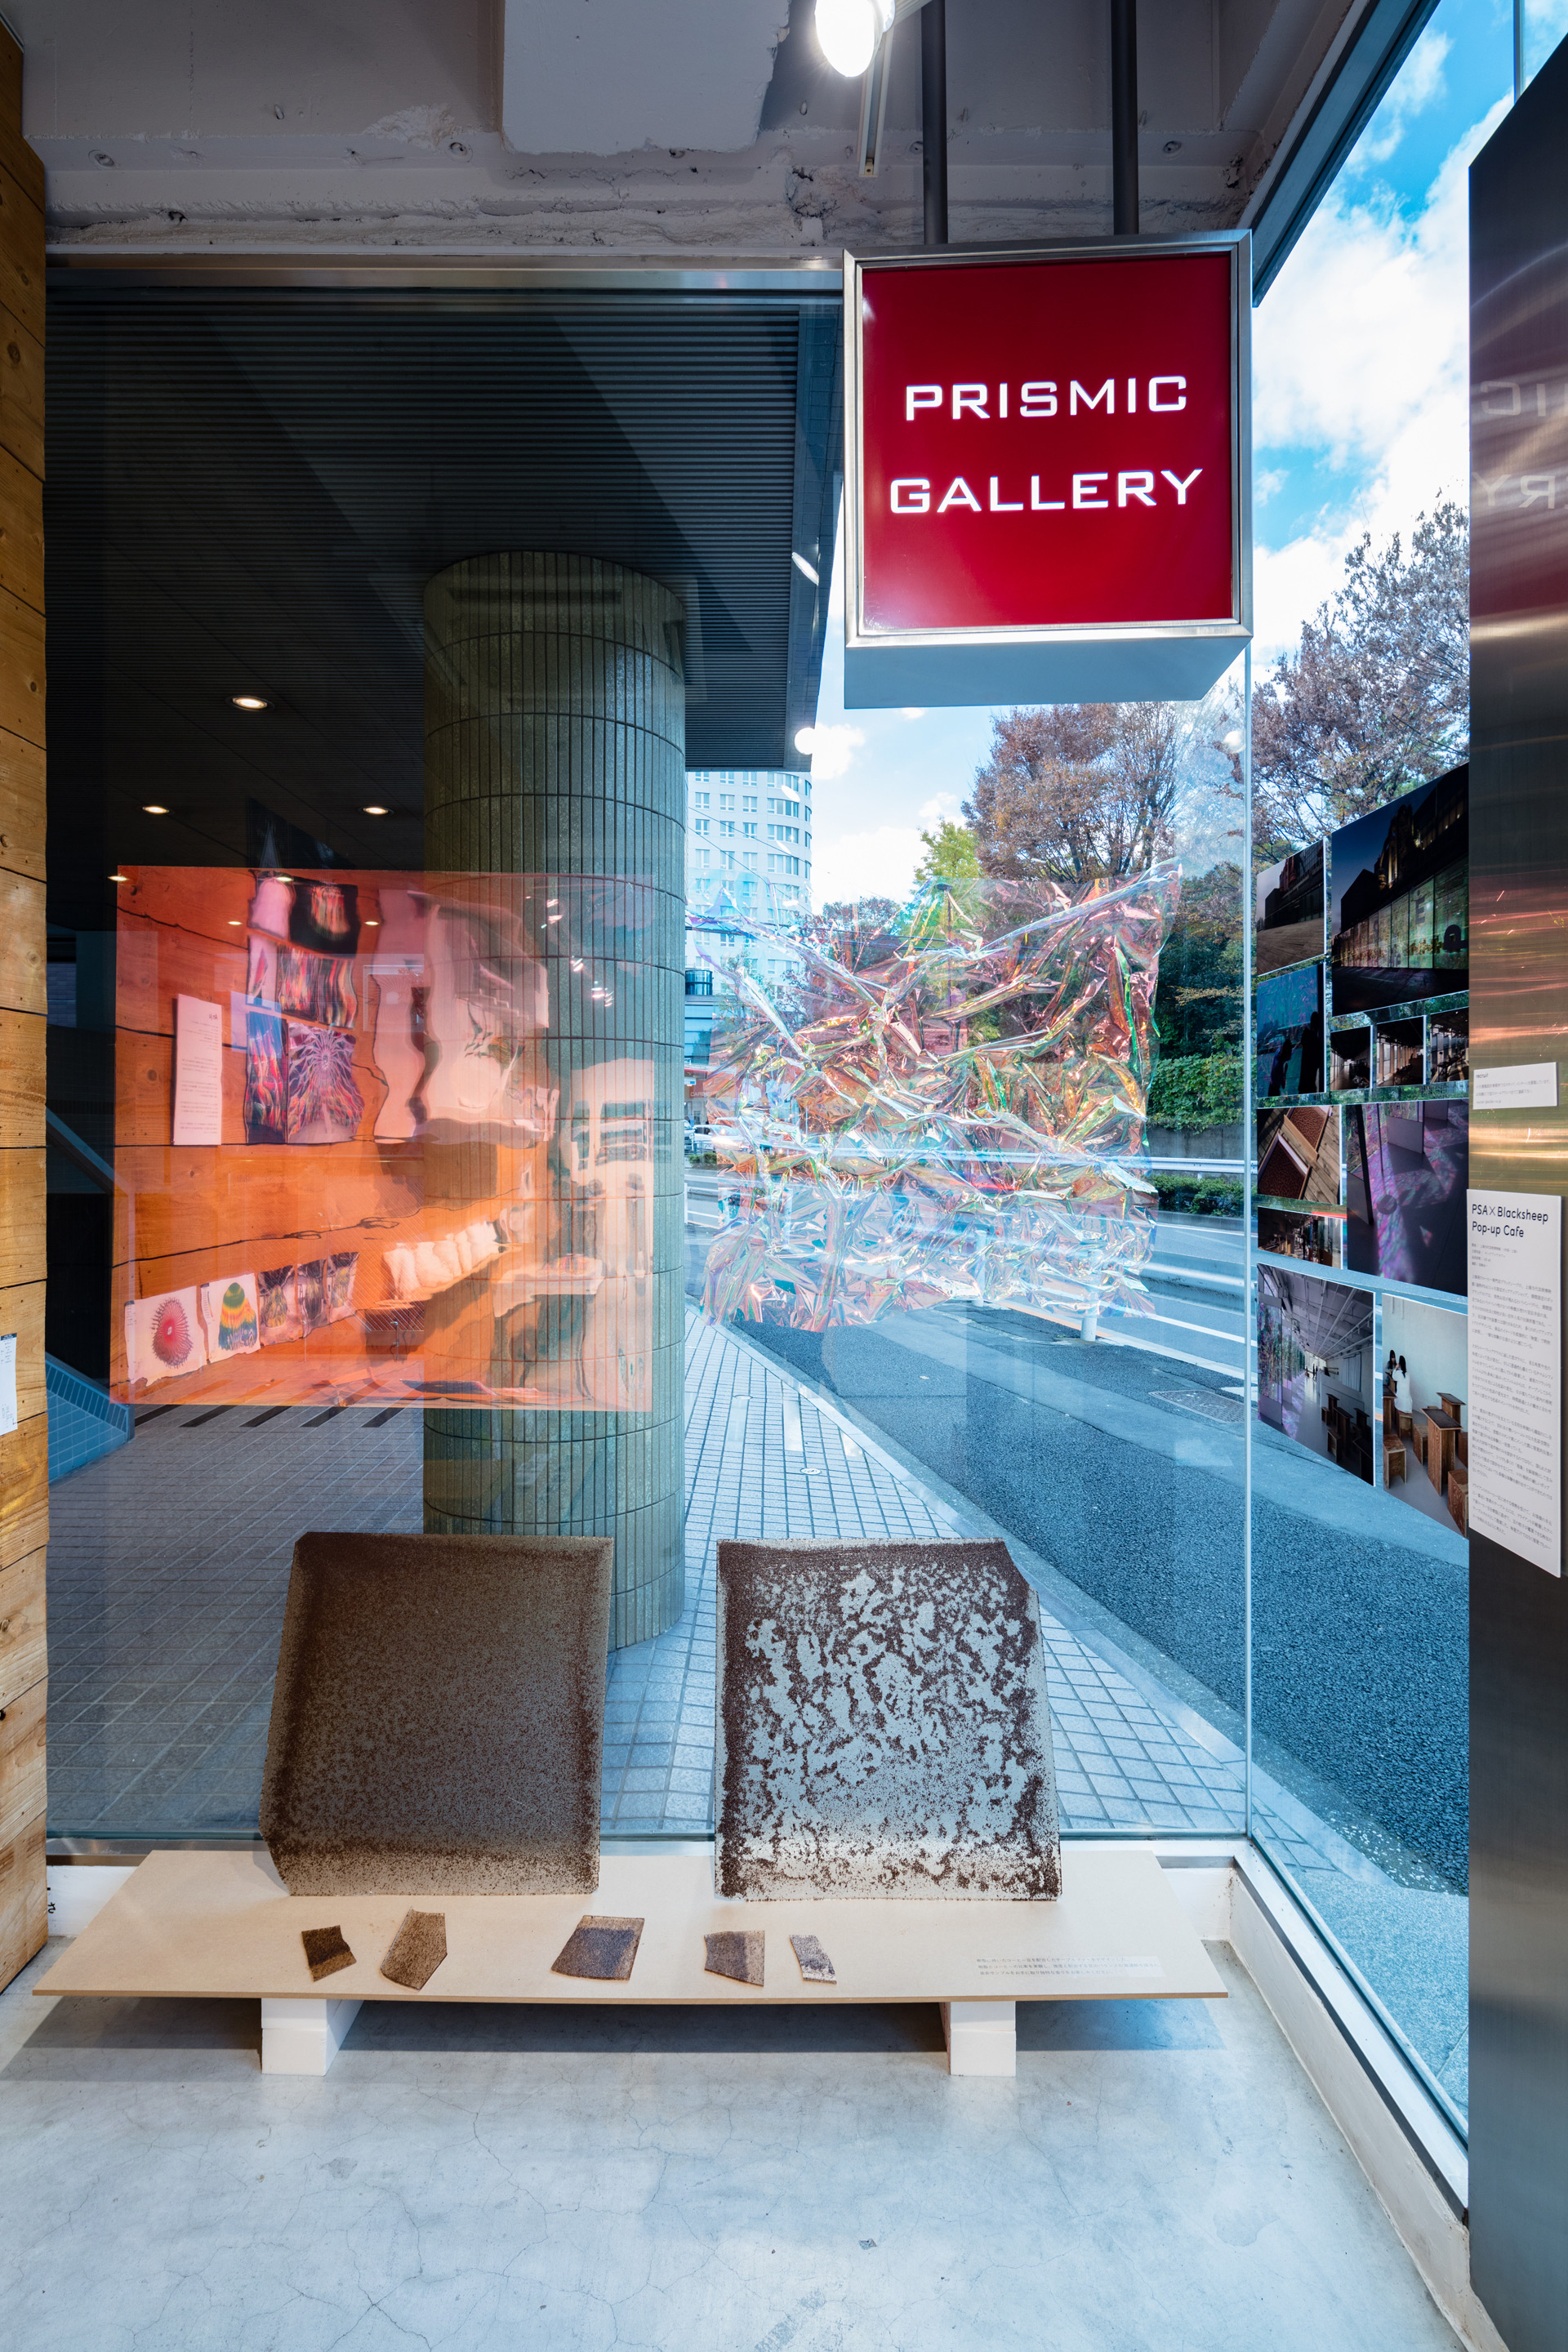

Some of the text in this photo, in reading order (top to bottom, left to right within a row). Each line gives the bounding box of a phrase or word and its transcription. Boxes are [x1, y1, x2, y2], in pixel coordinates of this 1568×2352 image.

[906, 376, 1187, 421] PRISMIC
[890, 468, 1203, 513] GALLERY
[1472, 1221, 1524, 1237] Pop-up Cafe
